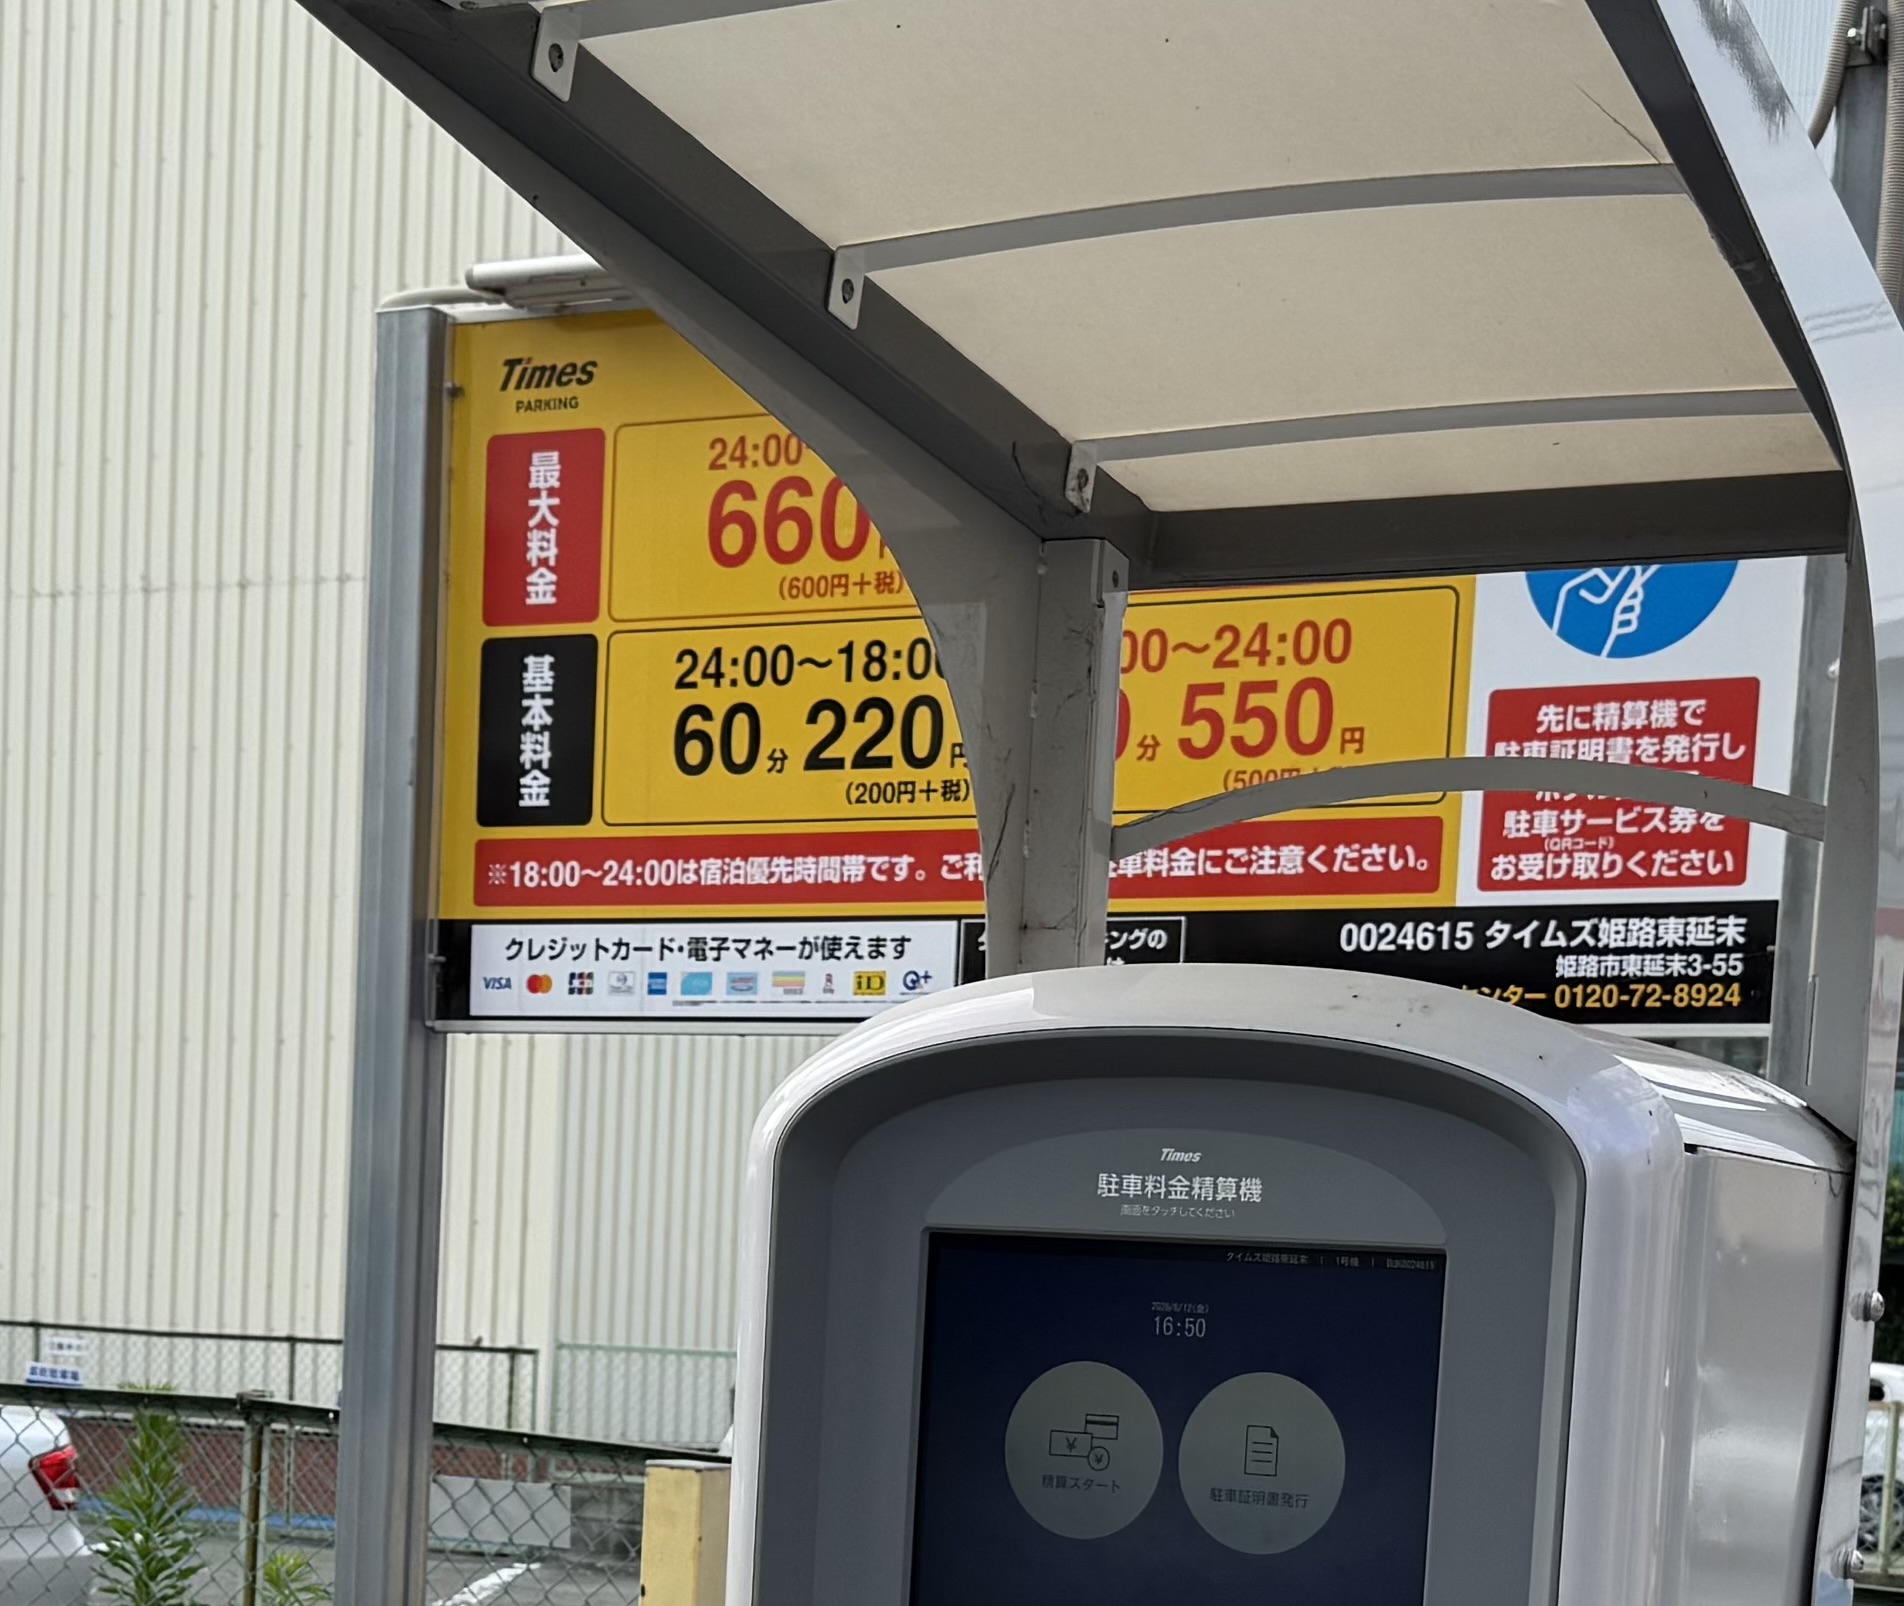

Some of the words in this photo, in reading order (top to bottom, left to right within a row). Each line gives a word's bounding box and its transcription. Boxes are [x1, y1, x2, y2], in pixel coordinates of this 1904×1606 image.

[499, 357, 598, 392] Times
[515, 397, 579, 414] PARKING
[709, 434, 810, 471] 24:00
[526, 452, 561, 605] 最大料金
[518, 653, 555, 808] 基本料金
[1536, 699, 1707, 733] 先に精算機で
[1503, 806, 1726, 838] 駐車サービス券を
[1108, 843, 1428, 879] 車料金にご注意ください。
[1490, 849, 1734, 881] お受け取りください
[504, 934, 912, 962] クレジットカード・電子マネーが使えます
[1339, 921, 1474, 952] 0024615
[1485, 916, 1747, 950] タイムズ姫路東延末
[1555, 954, 1744, 978] 姫路市東延末3-55
[483, 976, 512, 990] VISA
[1554, 982, 1741, 1009] 0120-72-8924
[1160, 1148, 1202, 1162] Times
[1097, 1173, 1263, 1202] 駐車料金精算機
[1154, 1316, 1207, 1338] 16:50
